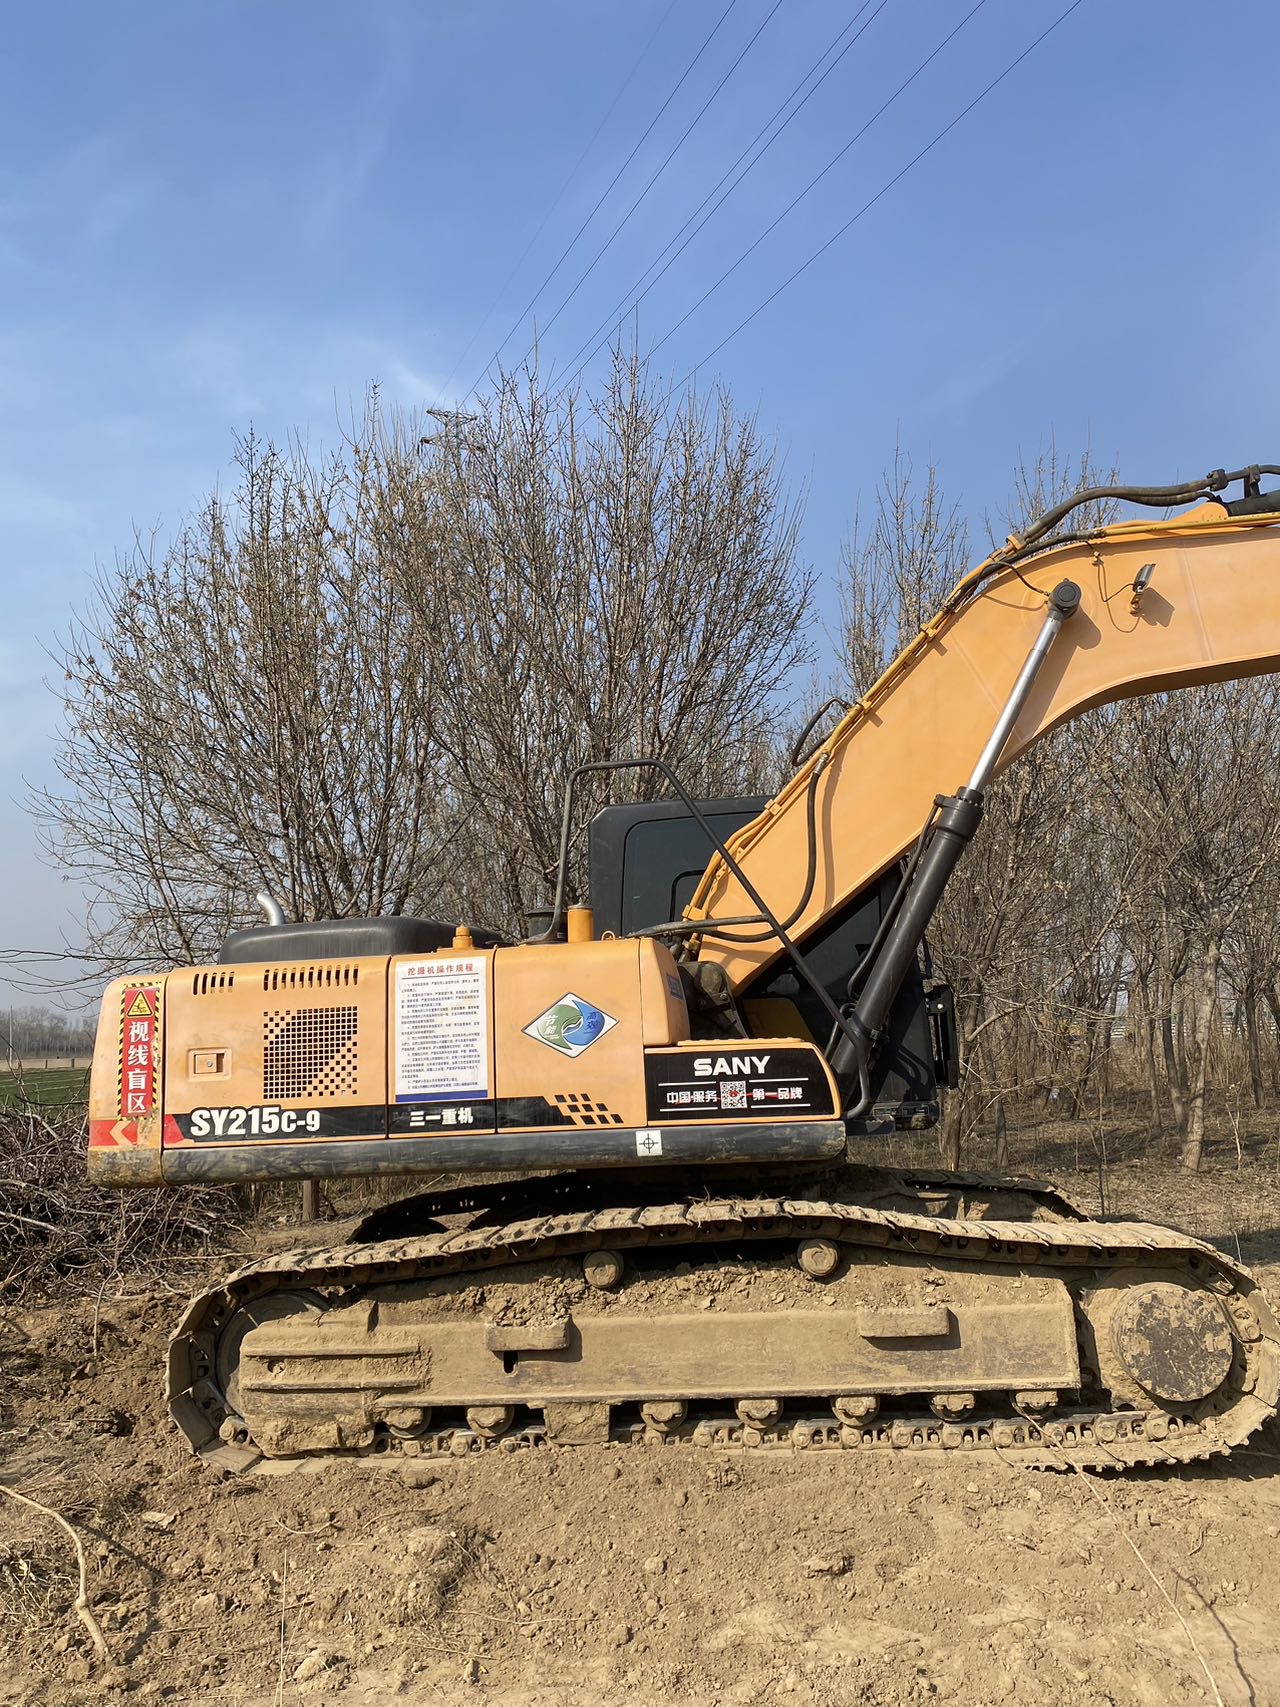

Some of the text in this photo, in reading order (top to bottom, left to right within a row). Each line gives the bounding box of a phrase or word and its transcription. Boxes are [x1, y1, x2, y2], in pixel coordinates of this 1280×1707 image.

[407, 963, 474, 976] 挖掘机操作规程
[544, 1014, 558, 1034] 节能
[127, 1021, 149, 1114] 视线盲区
[693, 1055, 771, 1077] SANY
[752, 1086, 803, 1101] 第一品牌
[409, 1107, 474, 1127] 三一重机
